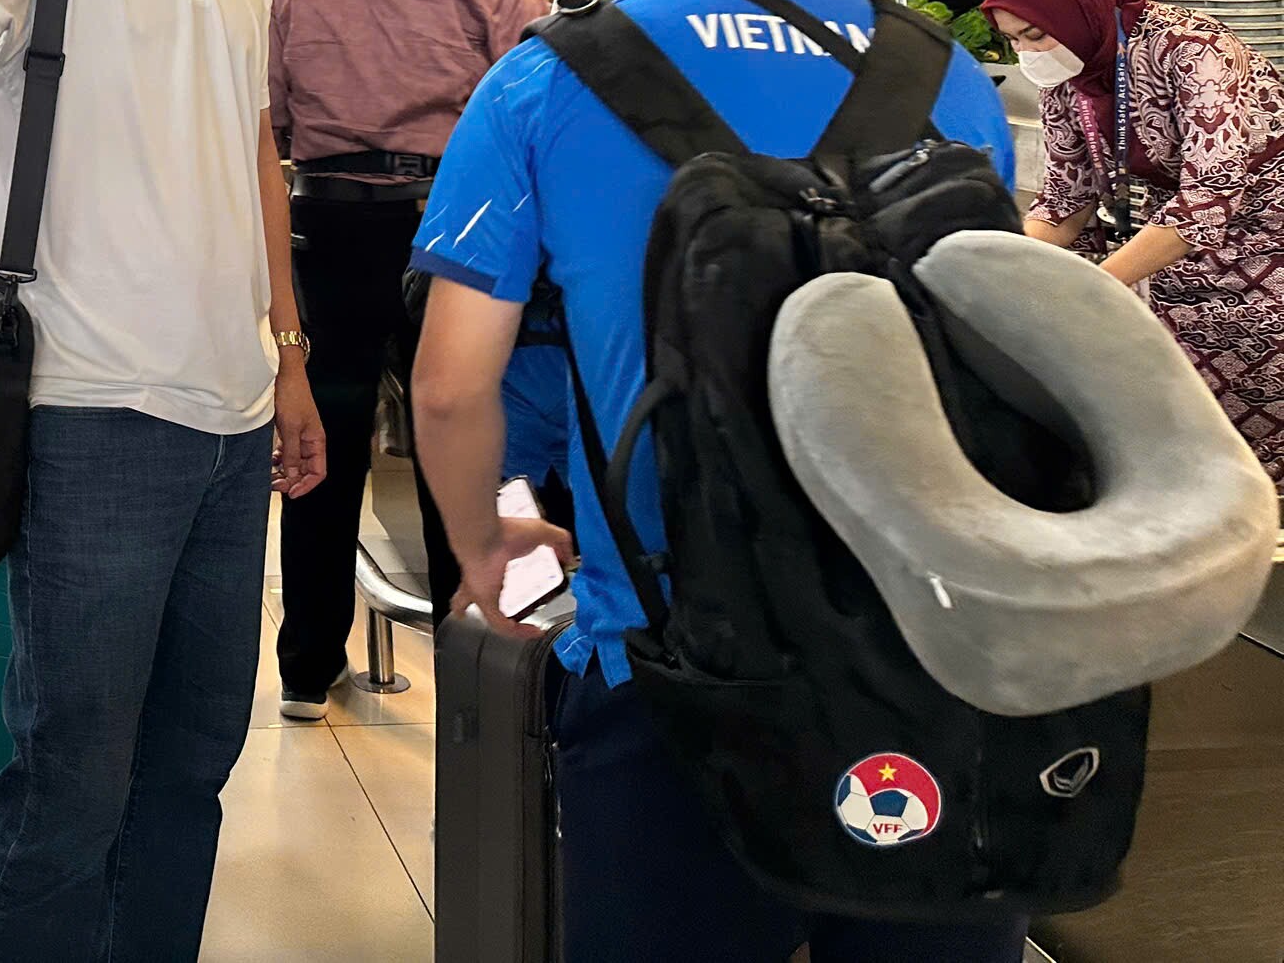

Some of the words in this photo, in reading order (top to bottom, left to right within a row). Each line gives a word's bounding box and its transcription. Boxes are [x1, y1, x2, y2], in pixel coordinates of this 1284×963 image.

[685, 13, 876, 57] VIETN
[1117, 62, 1126, 82] Safe
[1117, 83, 1127, 99] Act
[1117, 101, 1127, 124] Safe,
[1117, 126, 1127, 151] Think
[872, 822, 904, 835] VFF
